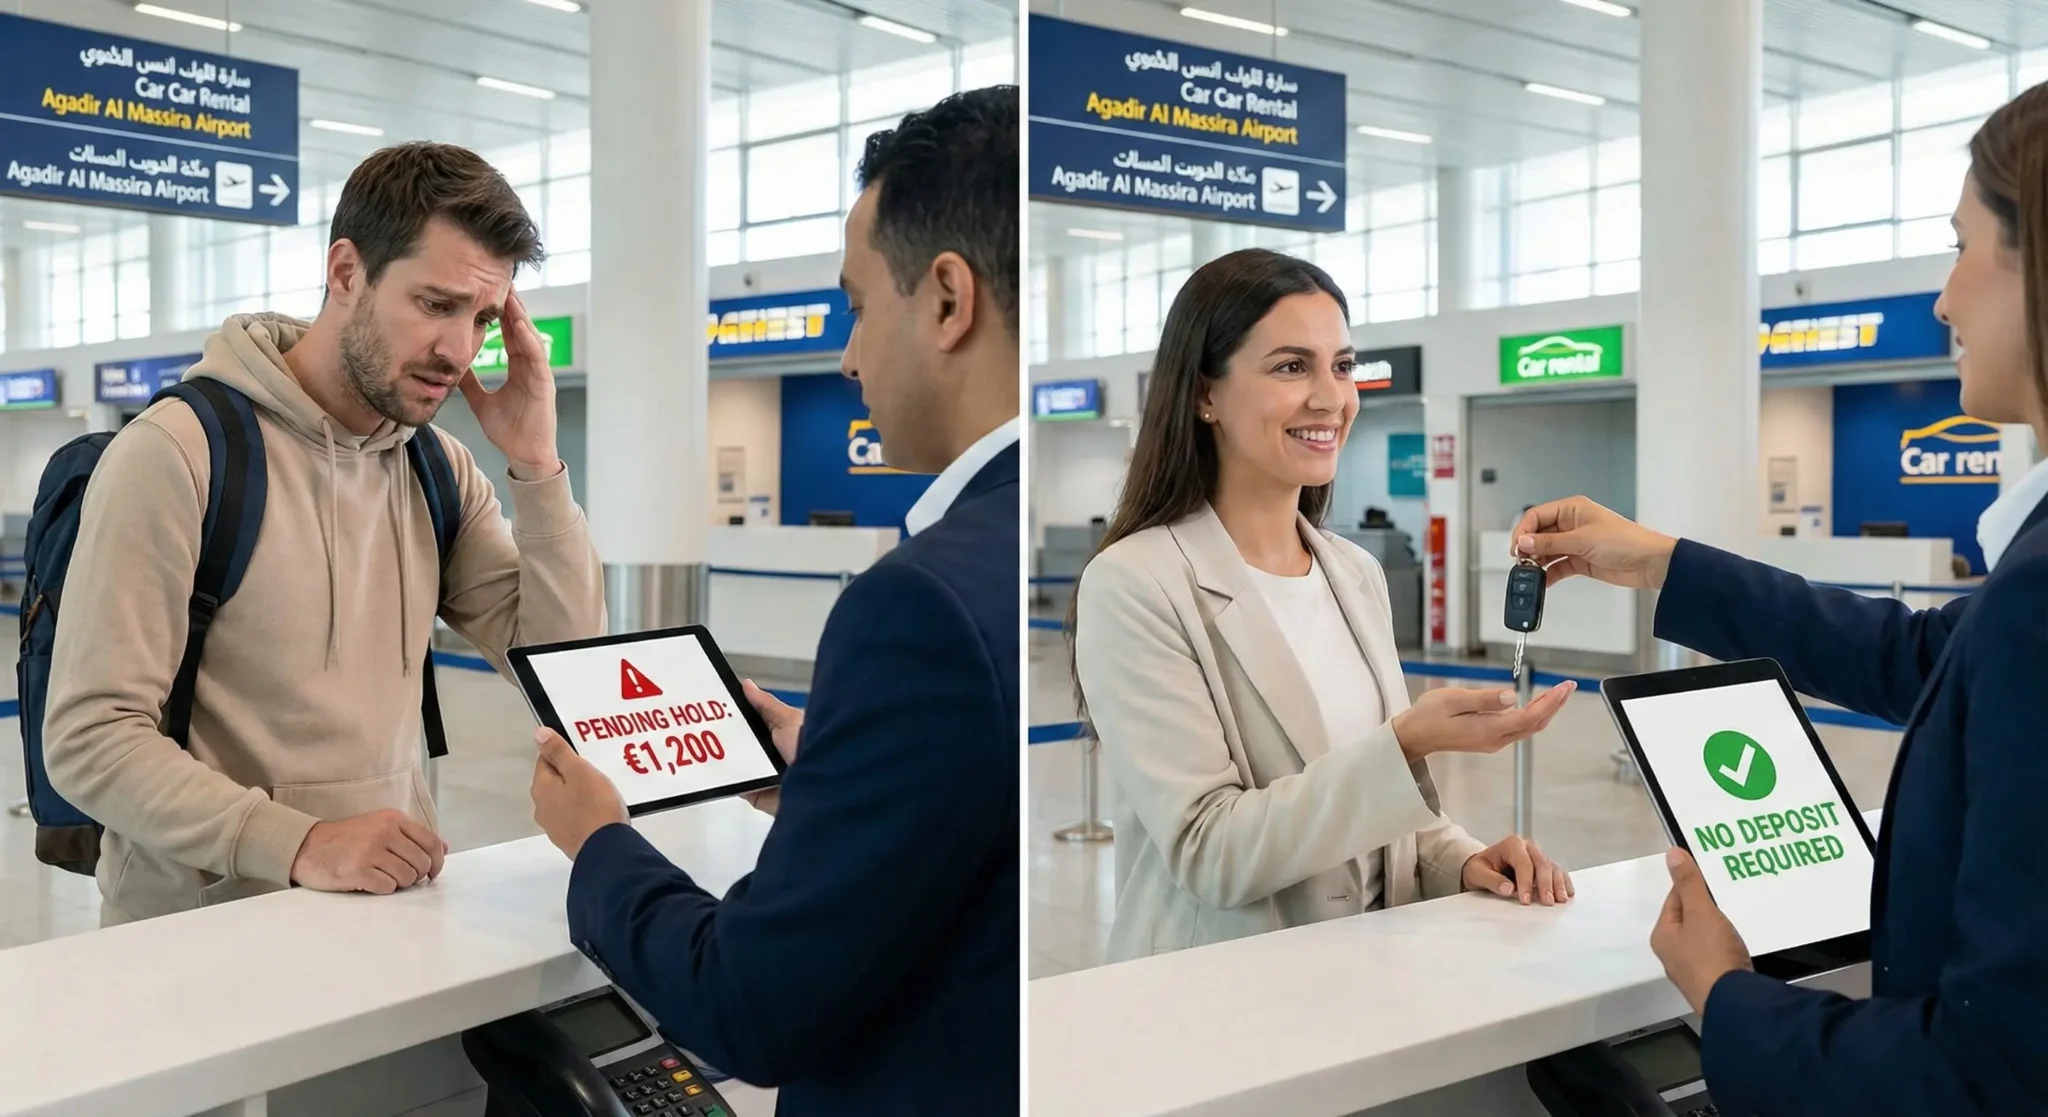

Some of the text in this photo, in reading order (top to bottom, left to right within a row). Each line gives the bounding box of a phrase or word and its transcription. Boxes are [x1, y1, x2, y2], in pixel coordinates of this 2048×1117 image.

[42, 88, 251, 139] Agadir Al Massira Airport
[135, 77, 250, 114] Car Car Rental
[1181, 82, 1298, 119] Car Car Rental
[1086, 92, 1298, 145] Agadir Al Massira Airport
[7, 160, 209, 204] Agadir Al Massira Airport
[1052, 166, 1256, 211] Agadir Al Massira Airport
[1517, 356, 1547, 377] Car
[848, 436, 883, 465] Ca
[1900, 446, 2003, 475] Car ren
[574, 700, 733, 742] PENDING HOLD:
[623, 730, 725, 775] €1,200
[1694, 802, 1840, 852] NO DEPOSIT
[1723, 835, 1844, 881] REQUIRED
